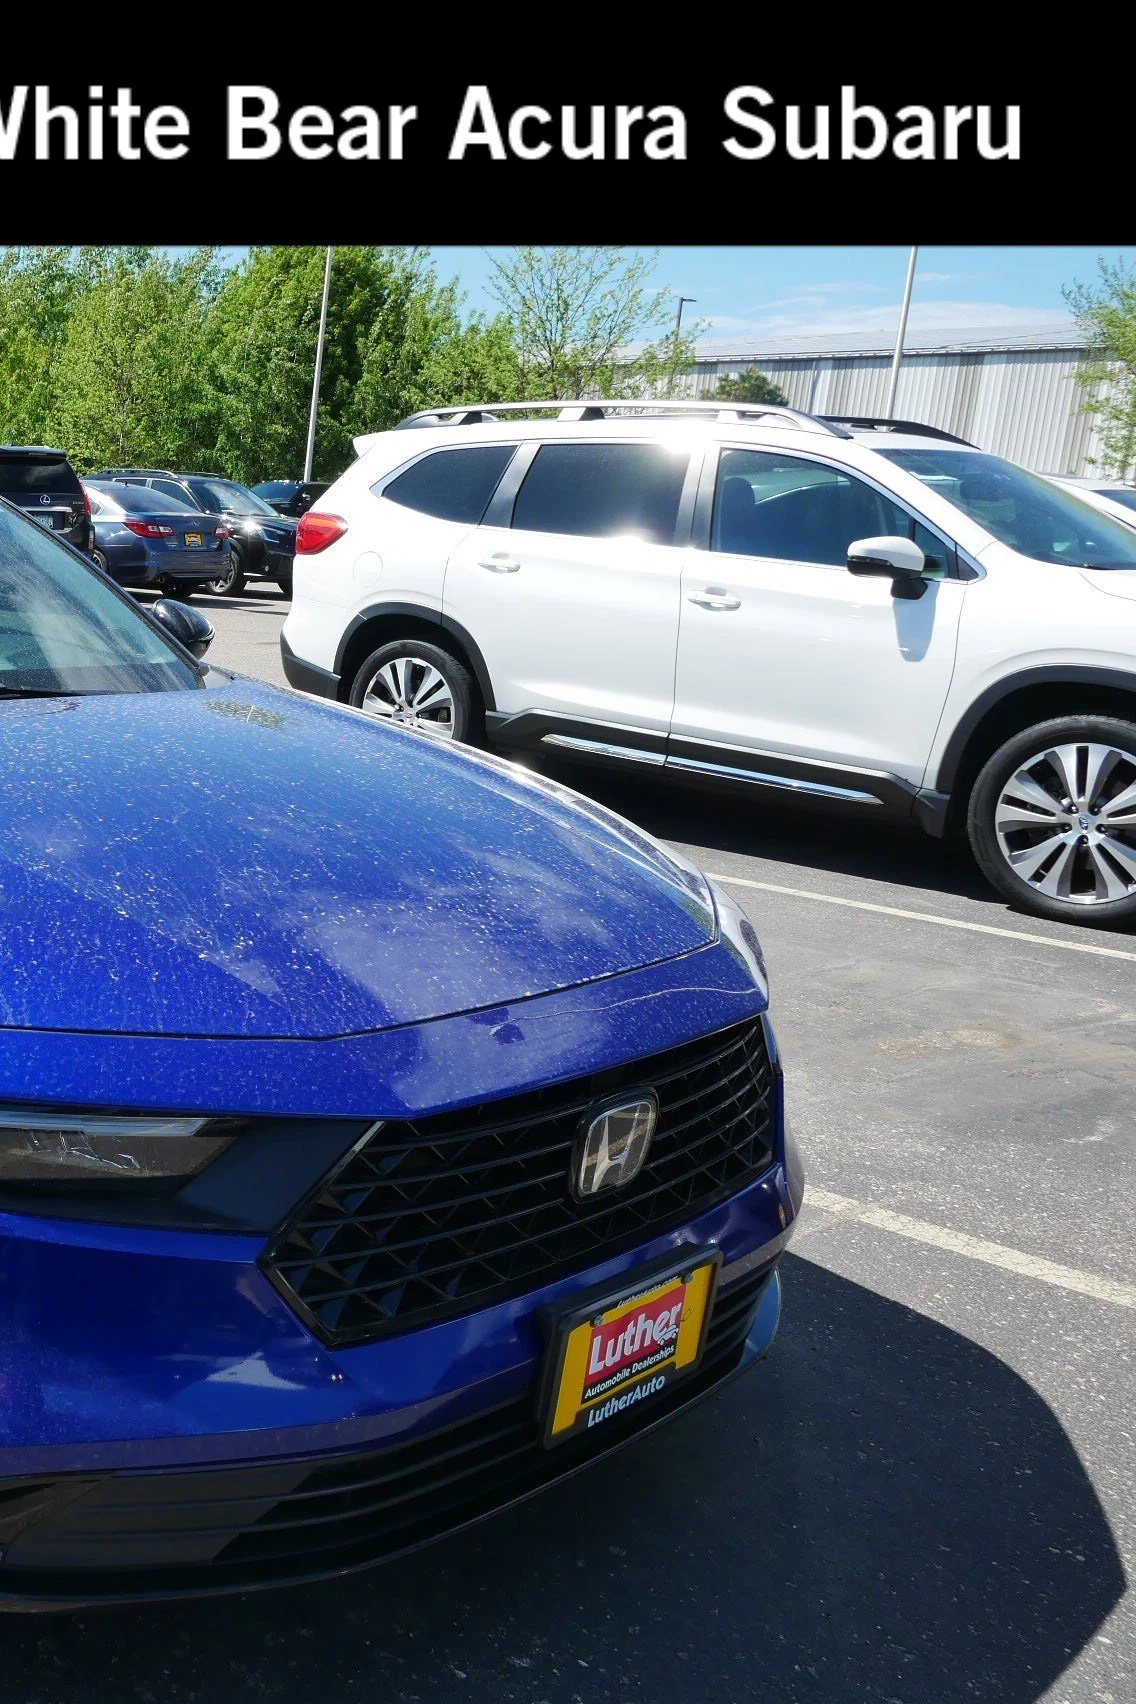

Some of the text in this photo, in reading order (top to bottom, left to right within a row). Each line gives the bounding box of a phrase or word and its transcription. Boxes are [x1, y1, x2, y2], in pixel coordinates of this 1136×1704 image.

[589, 1302, 682, 1376] Luther
[584, 1345, 675, 1399] Automobile Dealerships
[587, 1374, 666, 1429] LutherAuto
